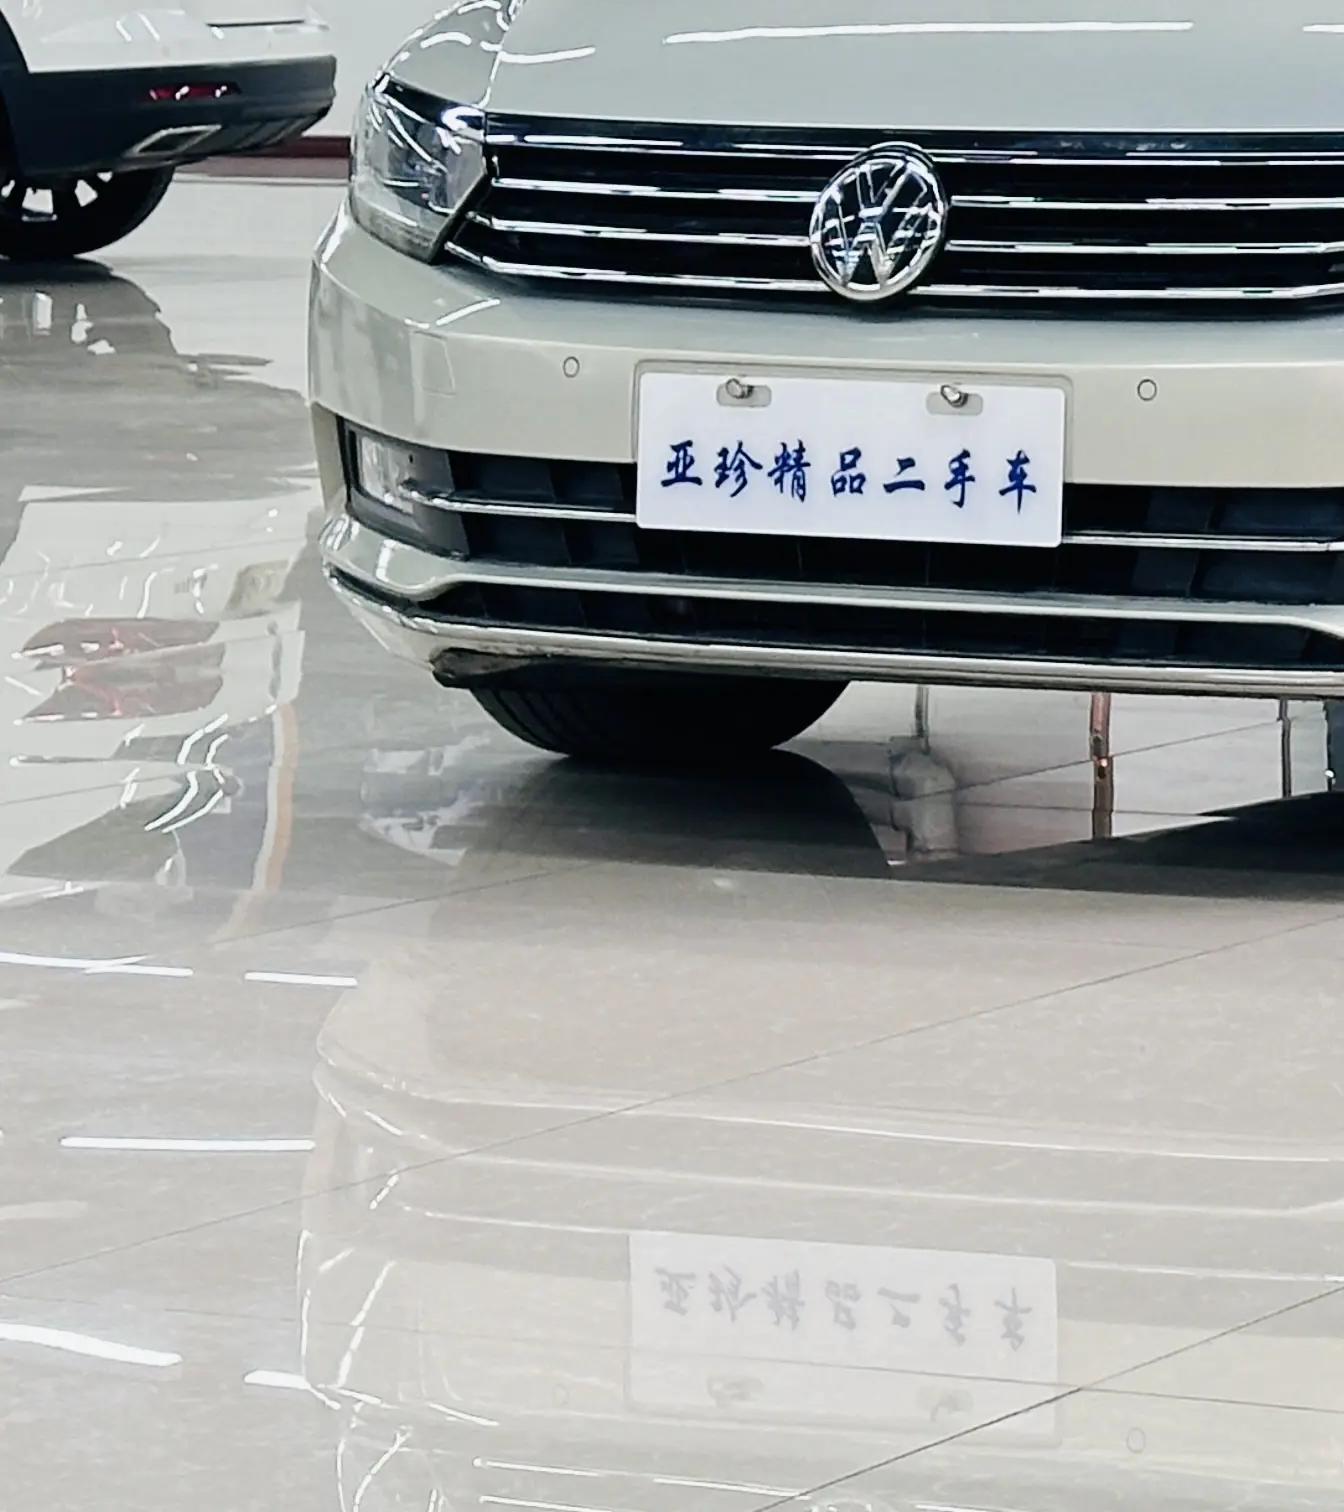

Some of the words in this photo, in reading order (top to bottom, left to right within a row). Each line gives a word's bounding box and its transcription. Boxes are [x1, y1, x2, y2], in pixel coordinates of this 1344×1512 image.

[660, 438, 1038, 515] 亚珍精品二手车
